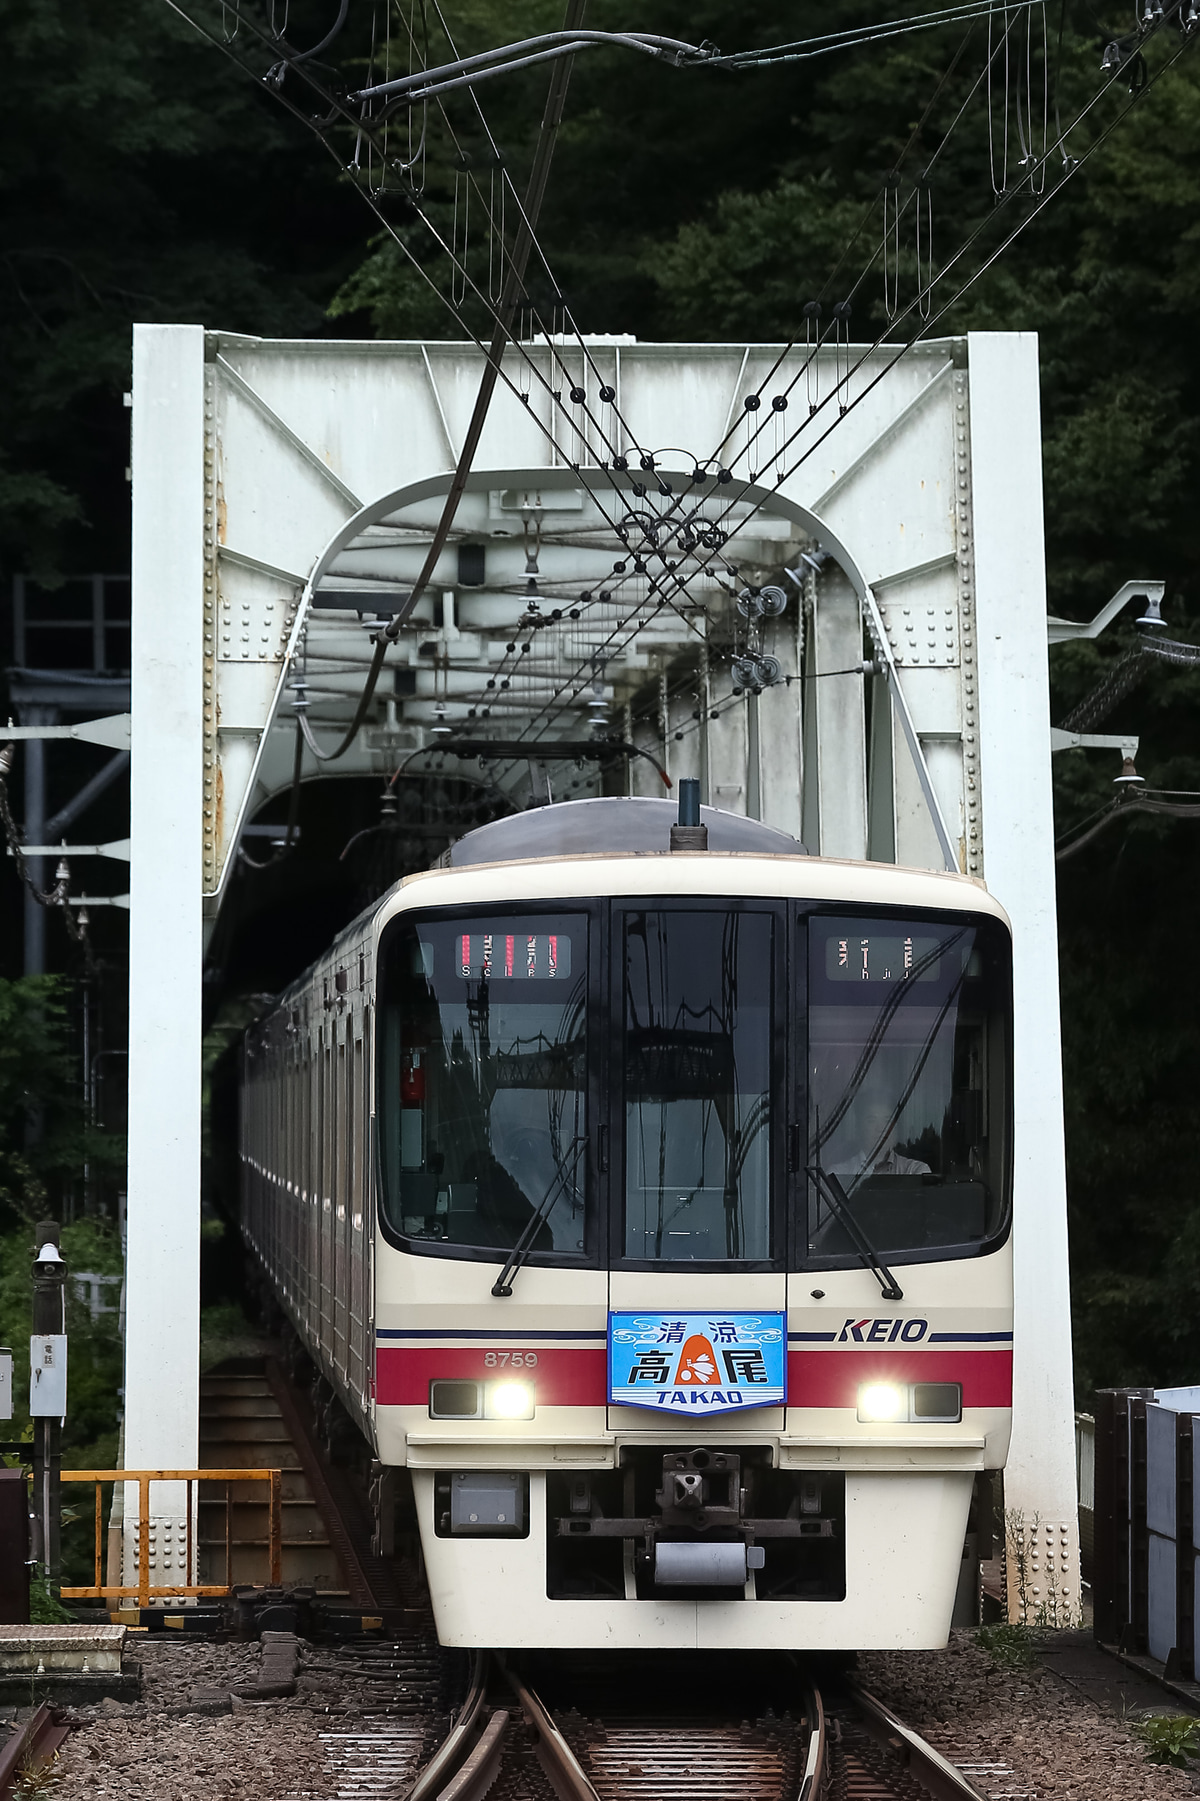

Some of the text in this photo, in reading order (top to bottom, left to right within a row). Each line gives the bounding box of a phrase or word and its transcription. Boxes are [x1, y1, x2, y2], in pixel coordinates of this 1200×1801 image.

[656, 1321, 739, 1344] 清涼
[838, 1319, 928, 1342] KEIO
[484, 1352, 538, 1368] 8759
[627, 1350, 768, 1384] 高尾
[656, 1391, 743, 1404] TAKAO
